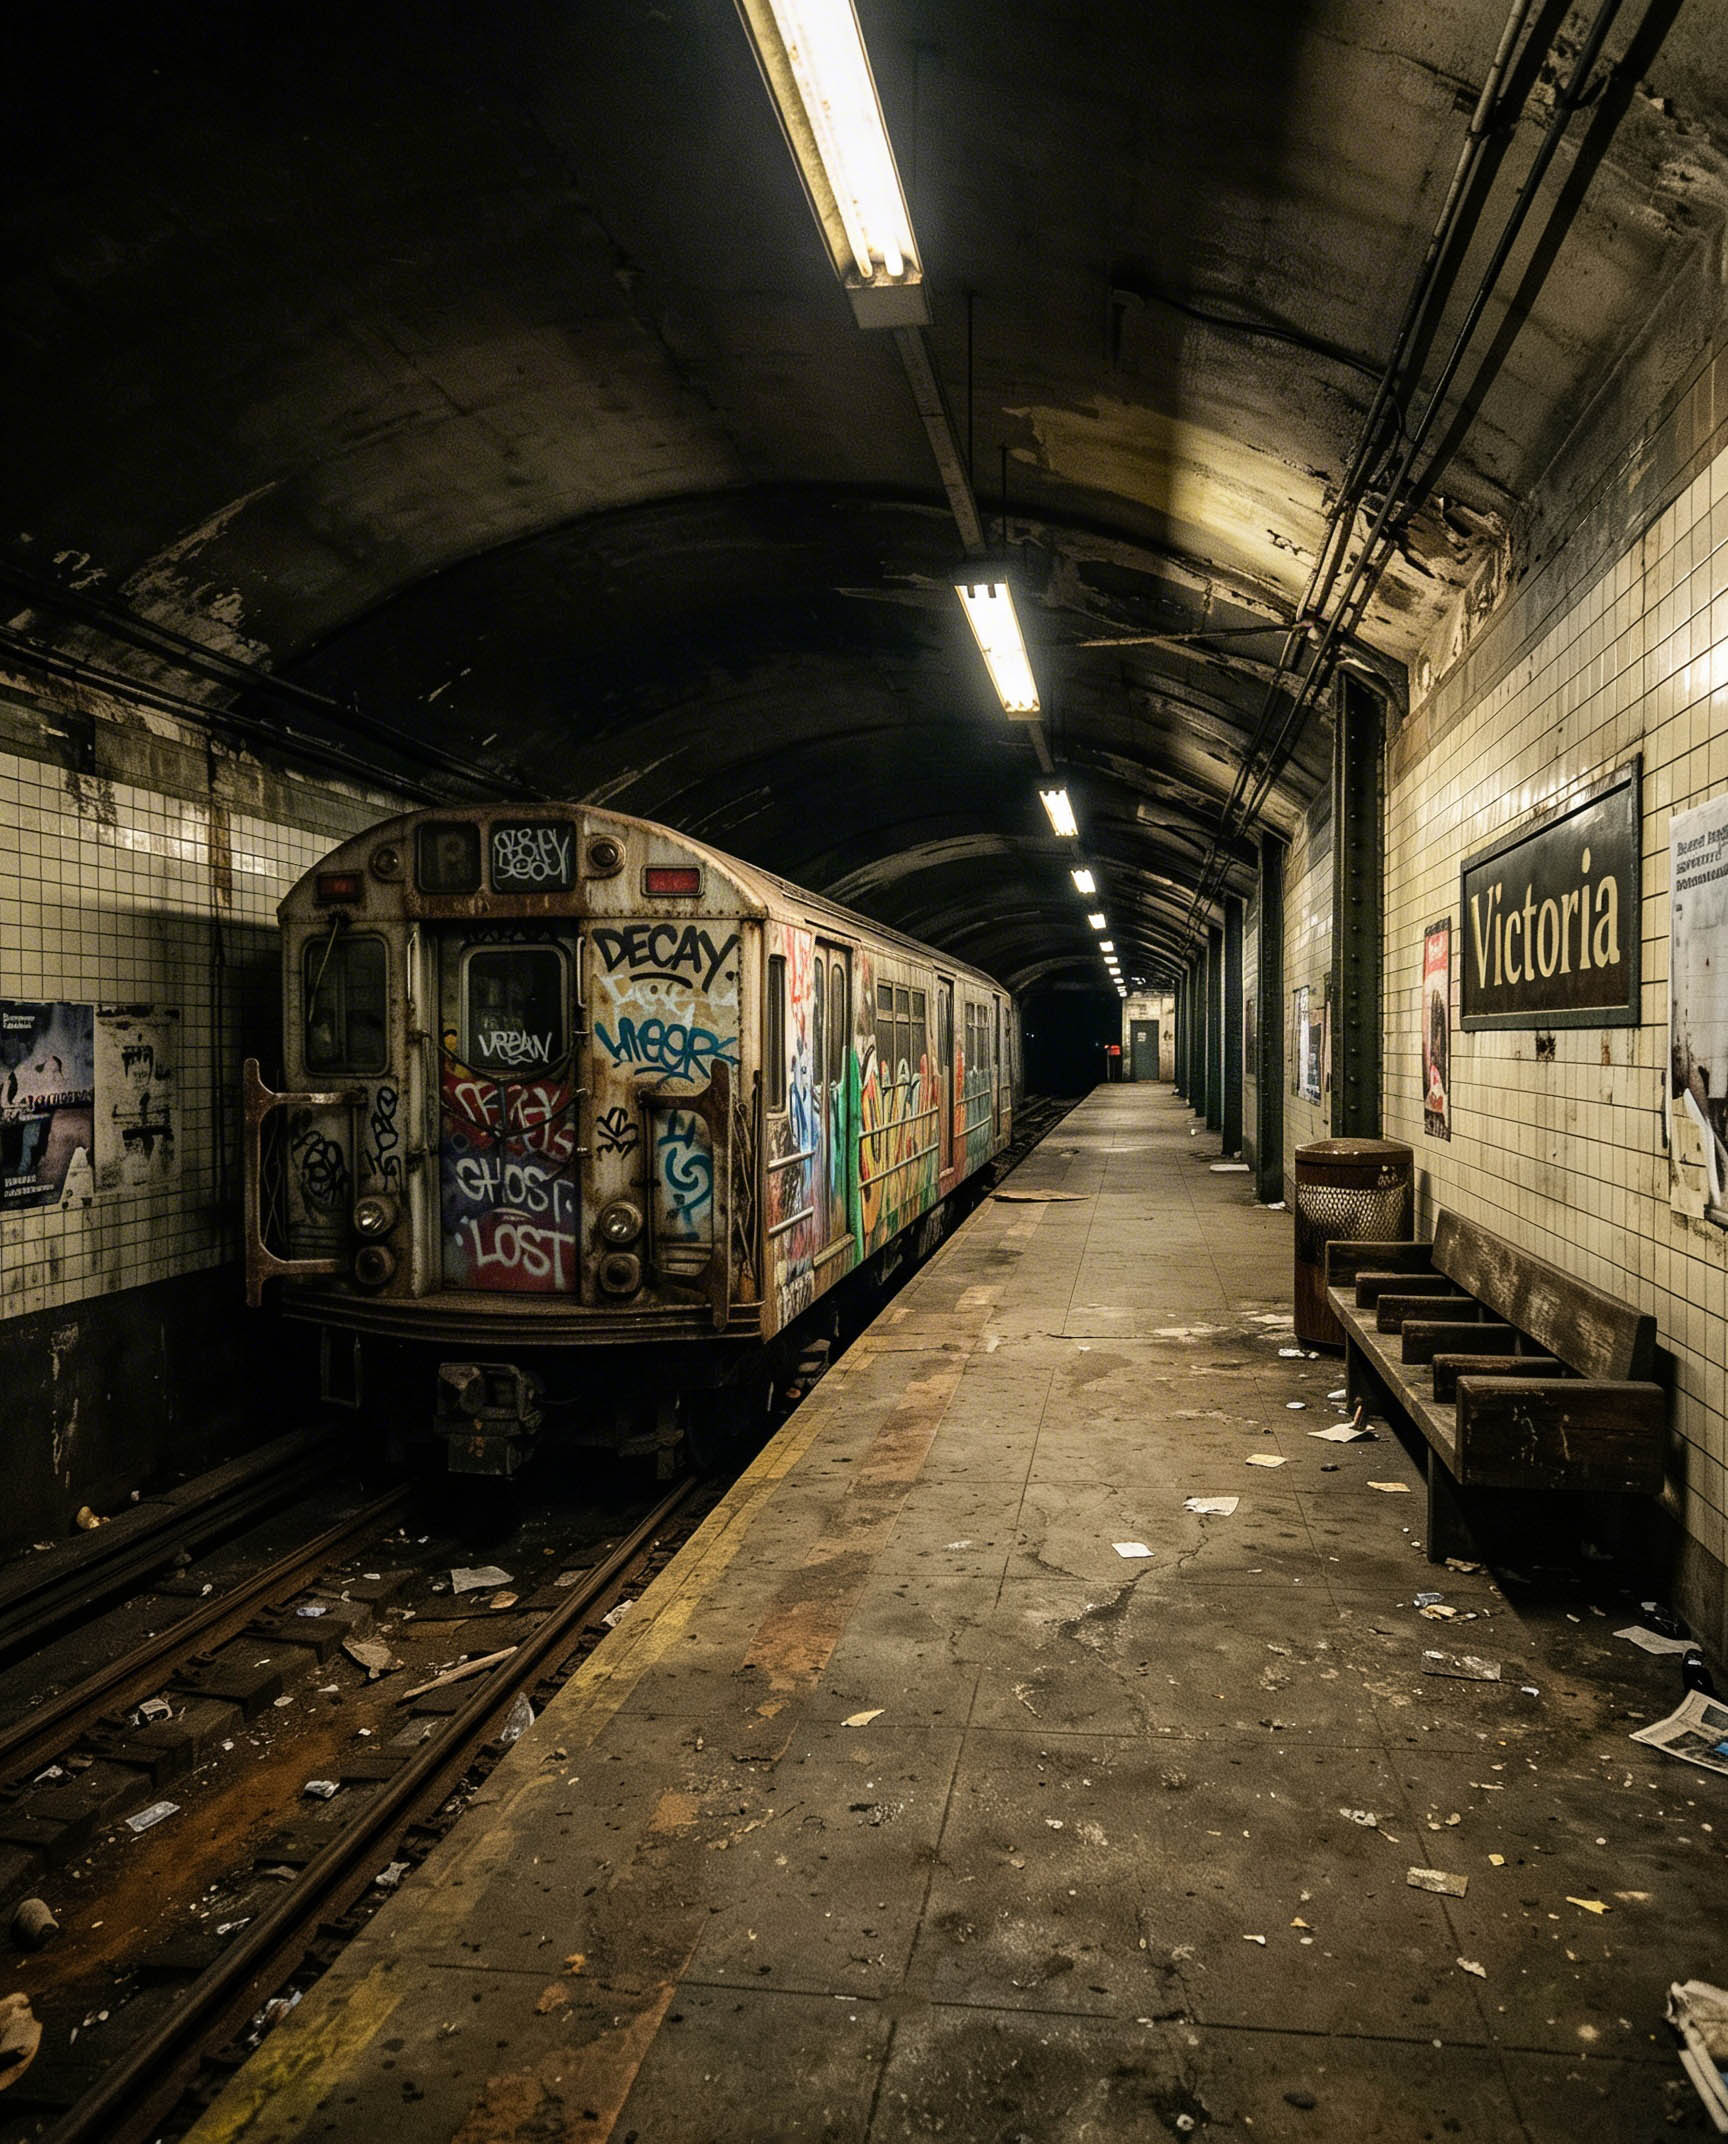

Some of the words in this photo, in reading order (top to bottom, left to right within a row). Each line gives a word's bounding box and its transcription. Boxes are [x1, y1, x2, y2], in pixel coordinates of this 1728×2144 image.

[1470, 847, 1621, 989] Victoria
[456, 1157, 575, 1224] GHOST
[469, 1218, 576, 1291] LOST
